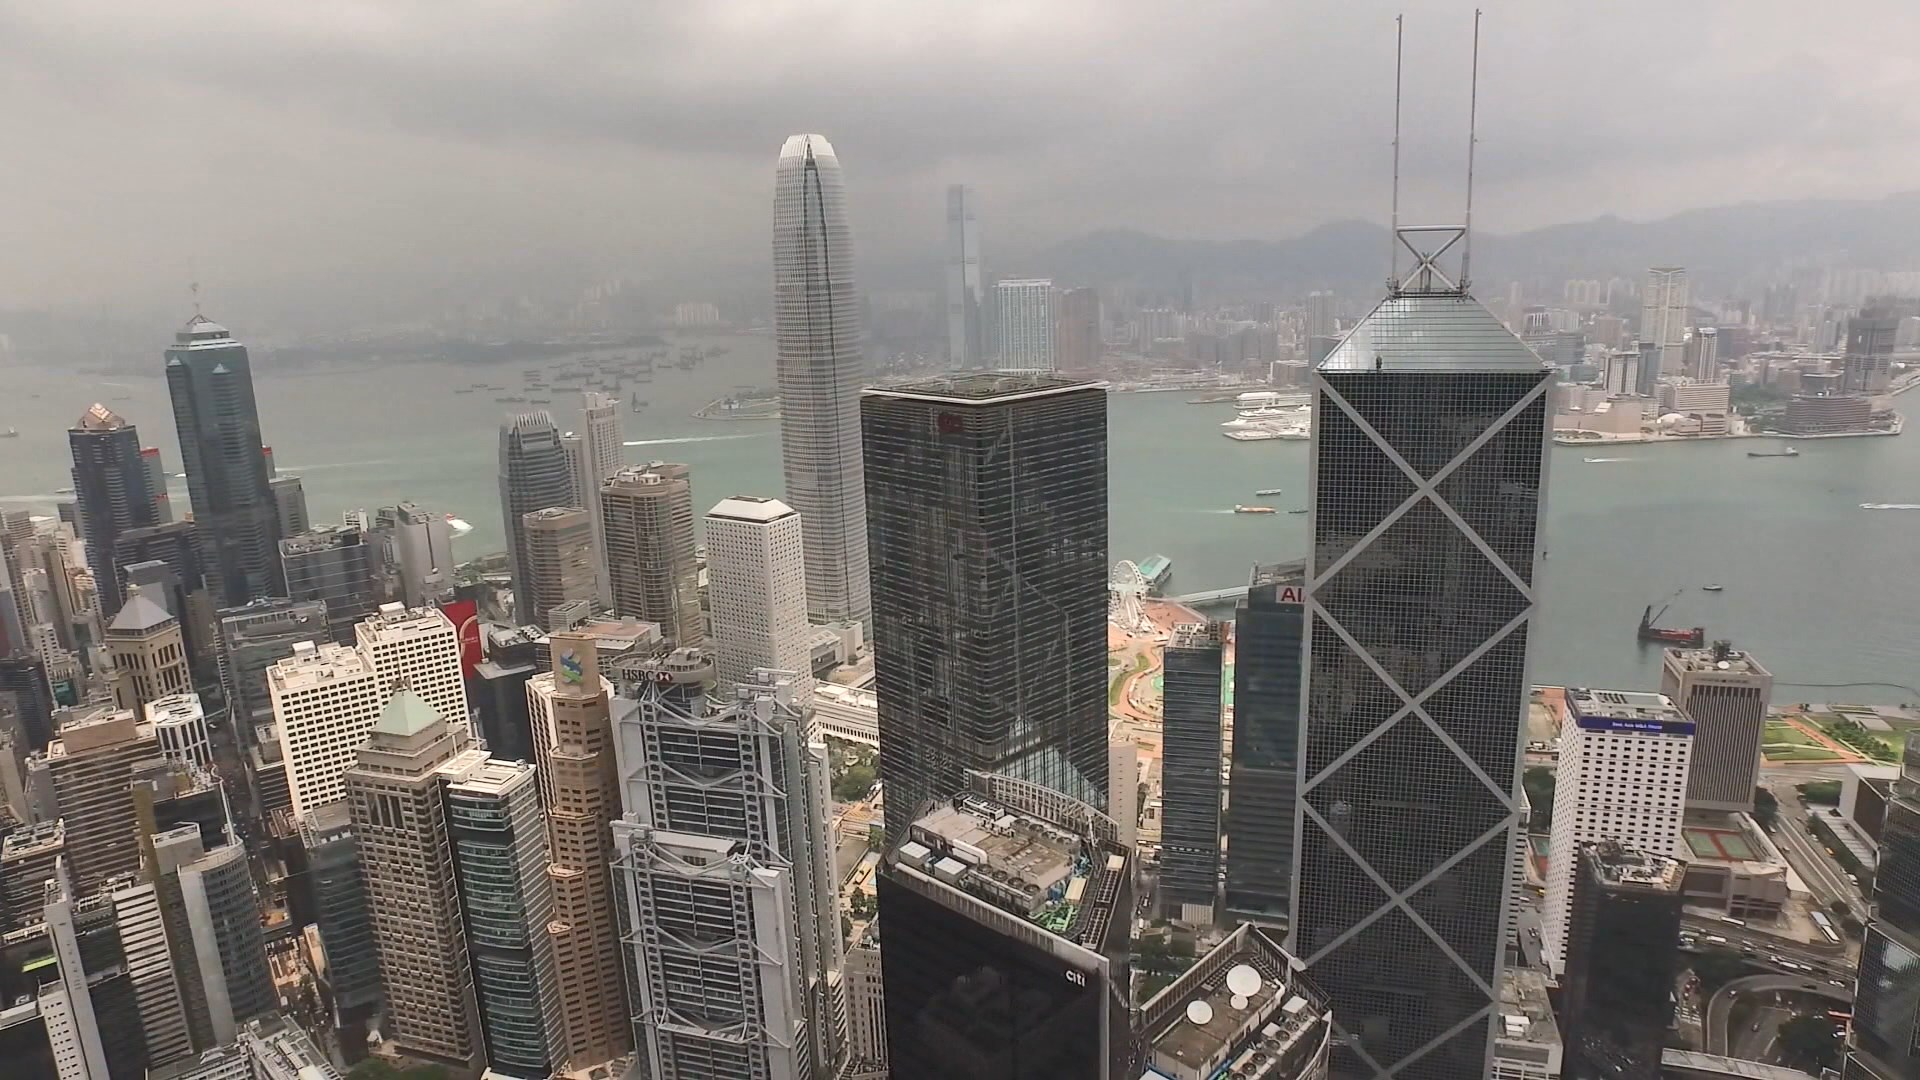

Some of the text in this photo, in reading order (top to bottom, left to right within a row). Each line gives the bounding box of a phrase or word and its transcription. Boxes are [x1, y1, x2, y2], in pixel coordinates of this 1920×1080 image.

[1280, 587, 1304, 602] AI
[622, 669, 654, 681] HSBC
[1065, 970, 1085, 987] citi
